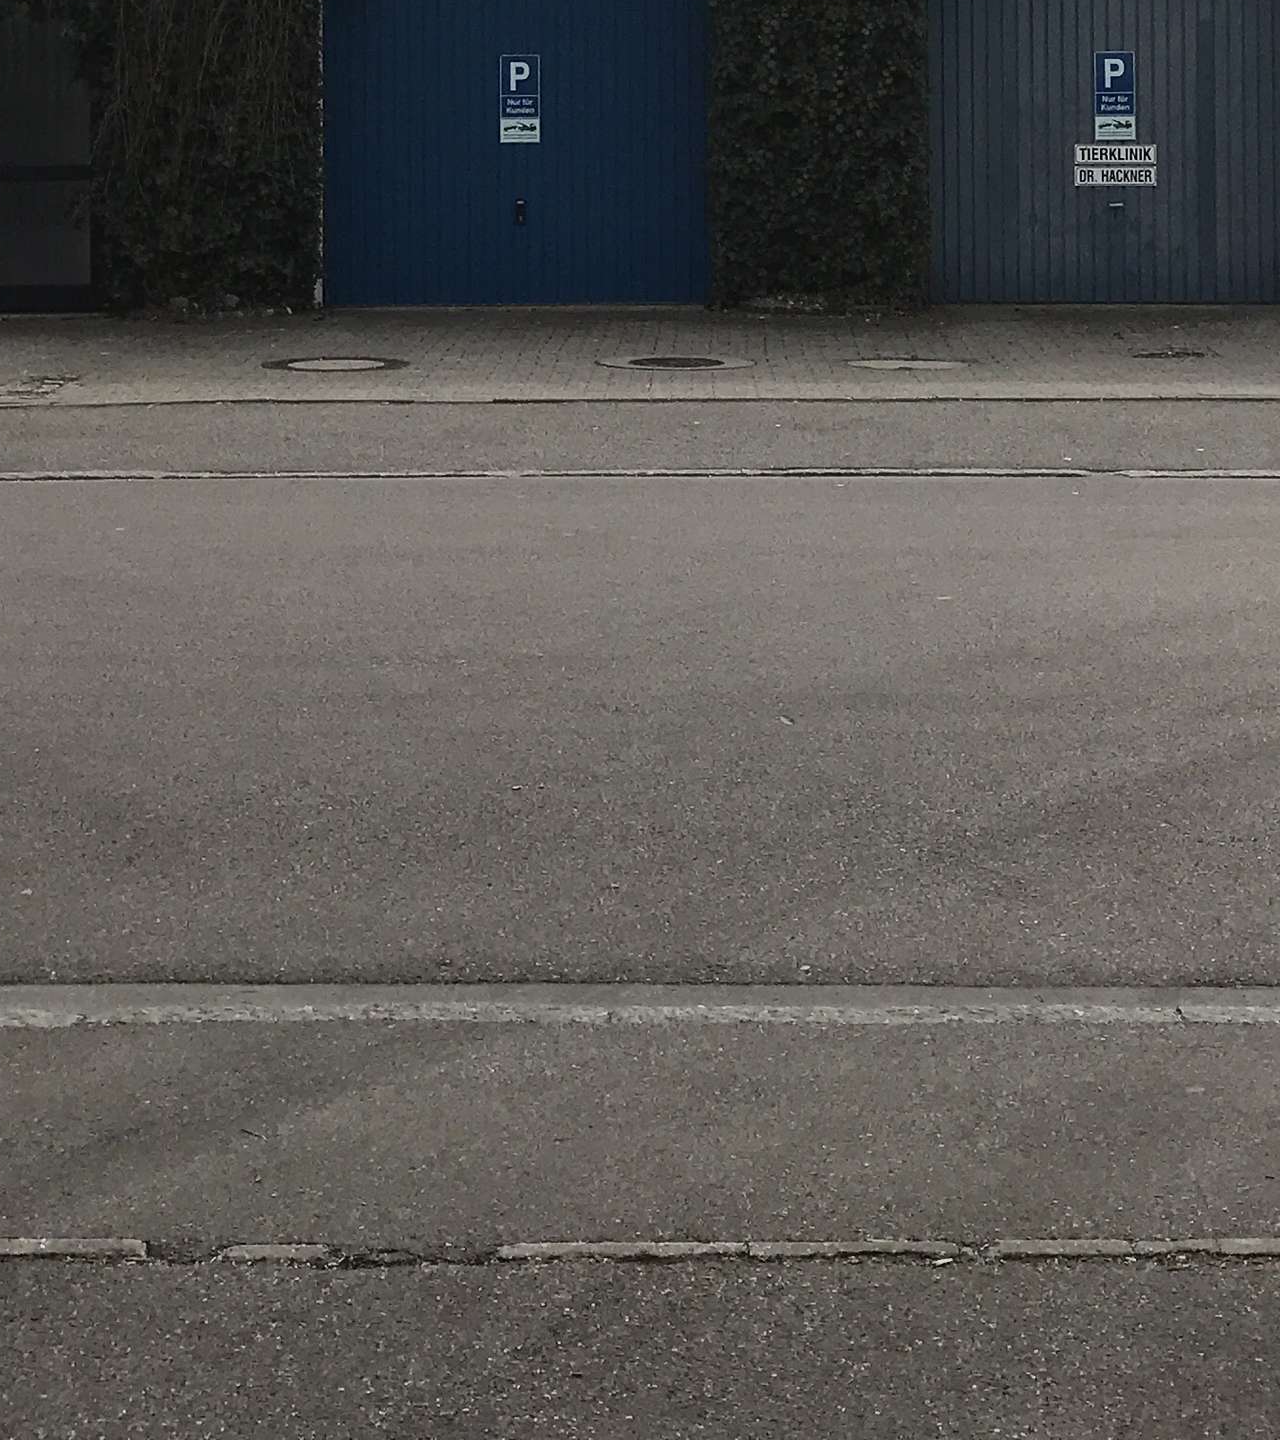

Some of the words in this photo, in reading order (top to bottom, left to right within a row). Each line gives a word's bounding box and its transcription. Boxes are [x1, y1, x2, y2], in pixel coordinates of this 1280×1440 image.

[510, 62, 530, 91] P
[1104, 58, 1125, 89] P
[507, 98, 521, 106] Nur
[522, 98, 533, 106] für
[1101, 95, 1116, 103] Nur
[1101, 103, 1130, 111] Kunden
[1080, 148, 1151, 161] TIERKLINIK
[1080, 169, 1098, 182] DR.
[1102, 169, 1151, 182] HACKNER
